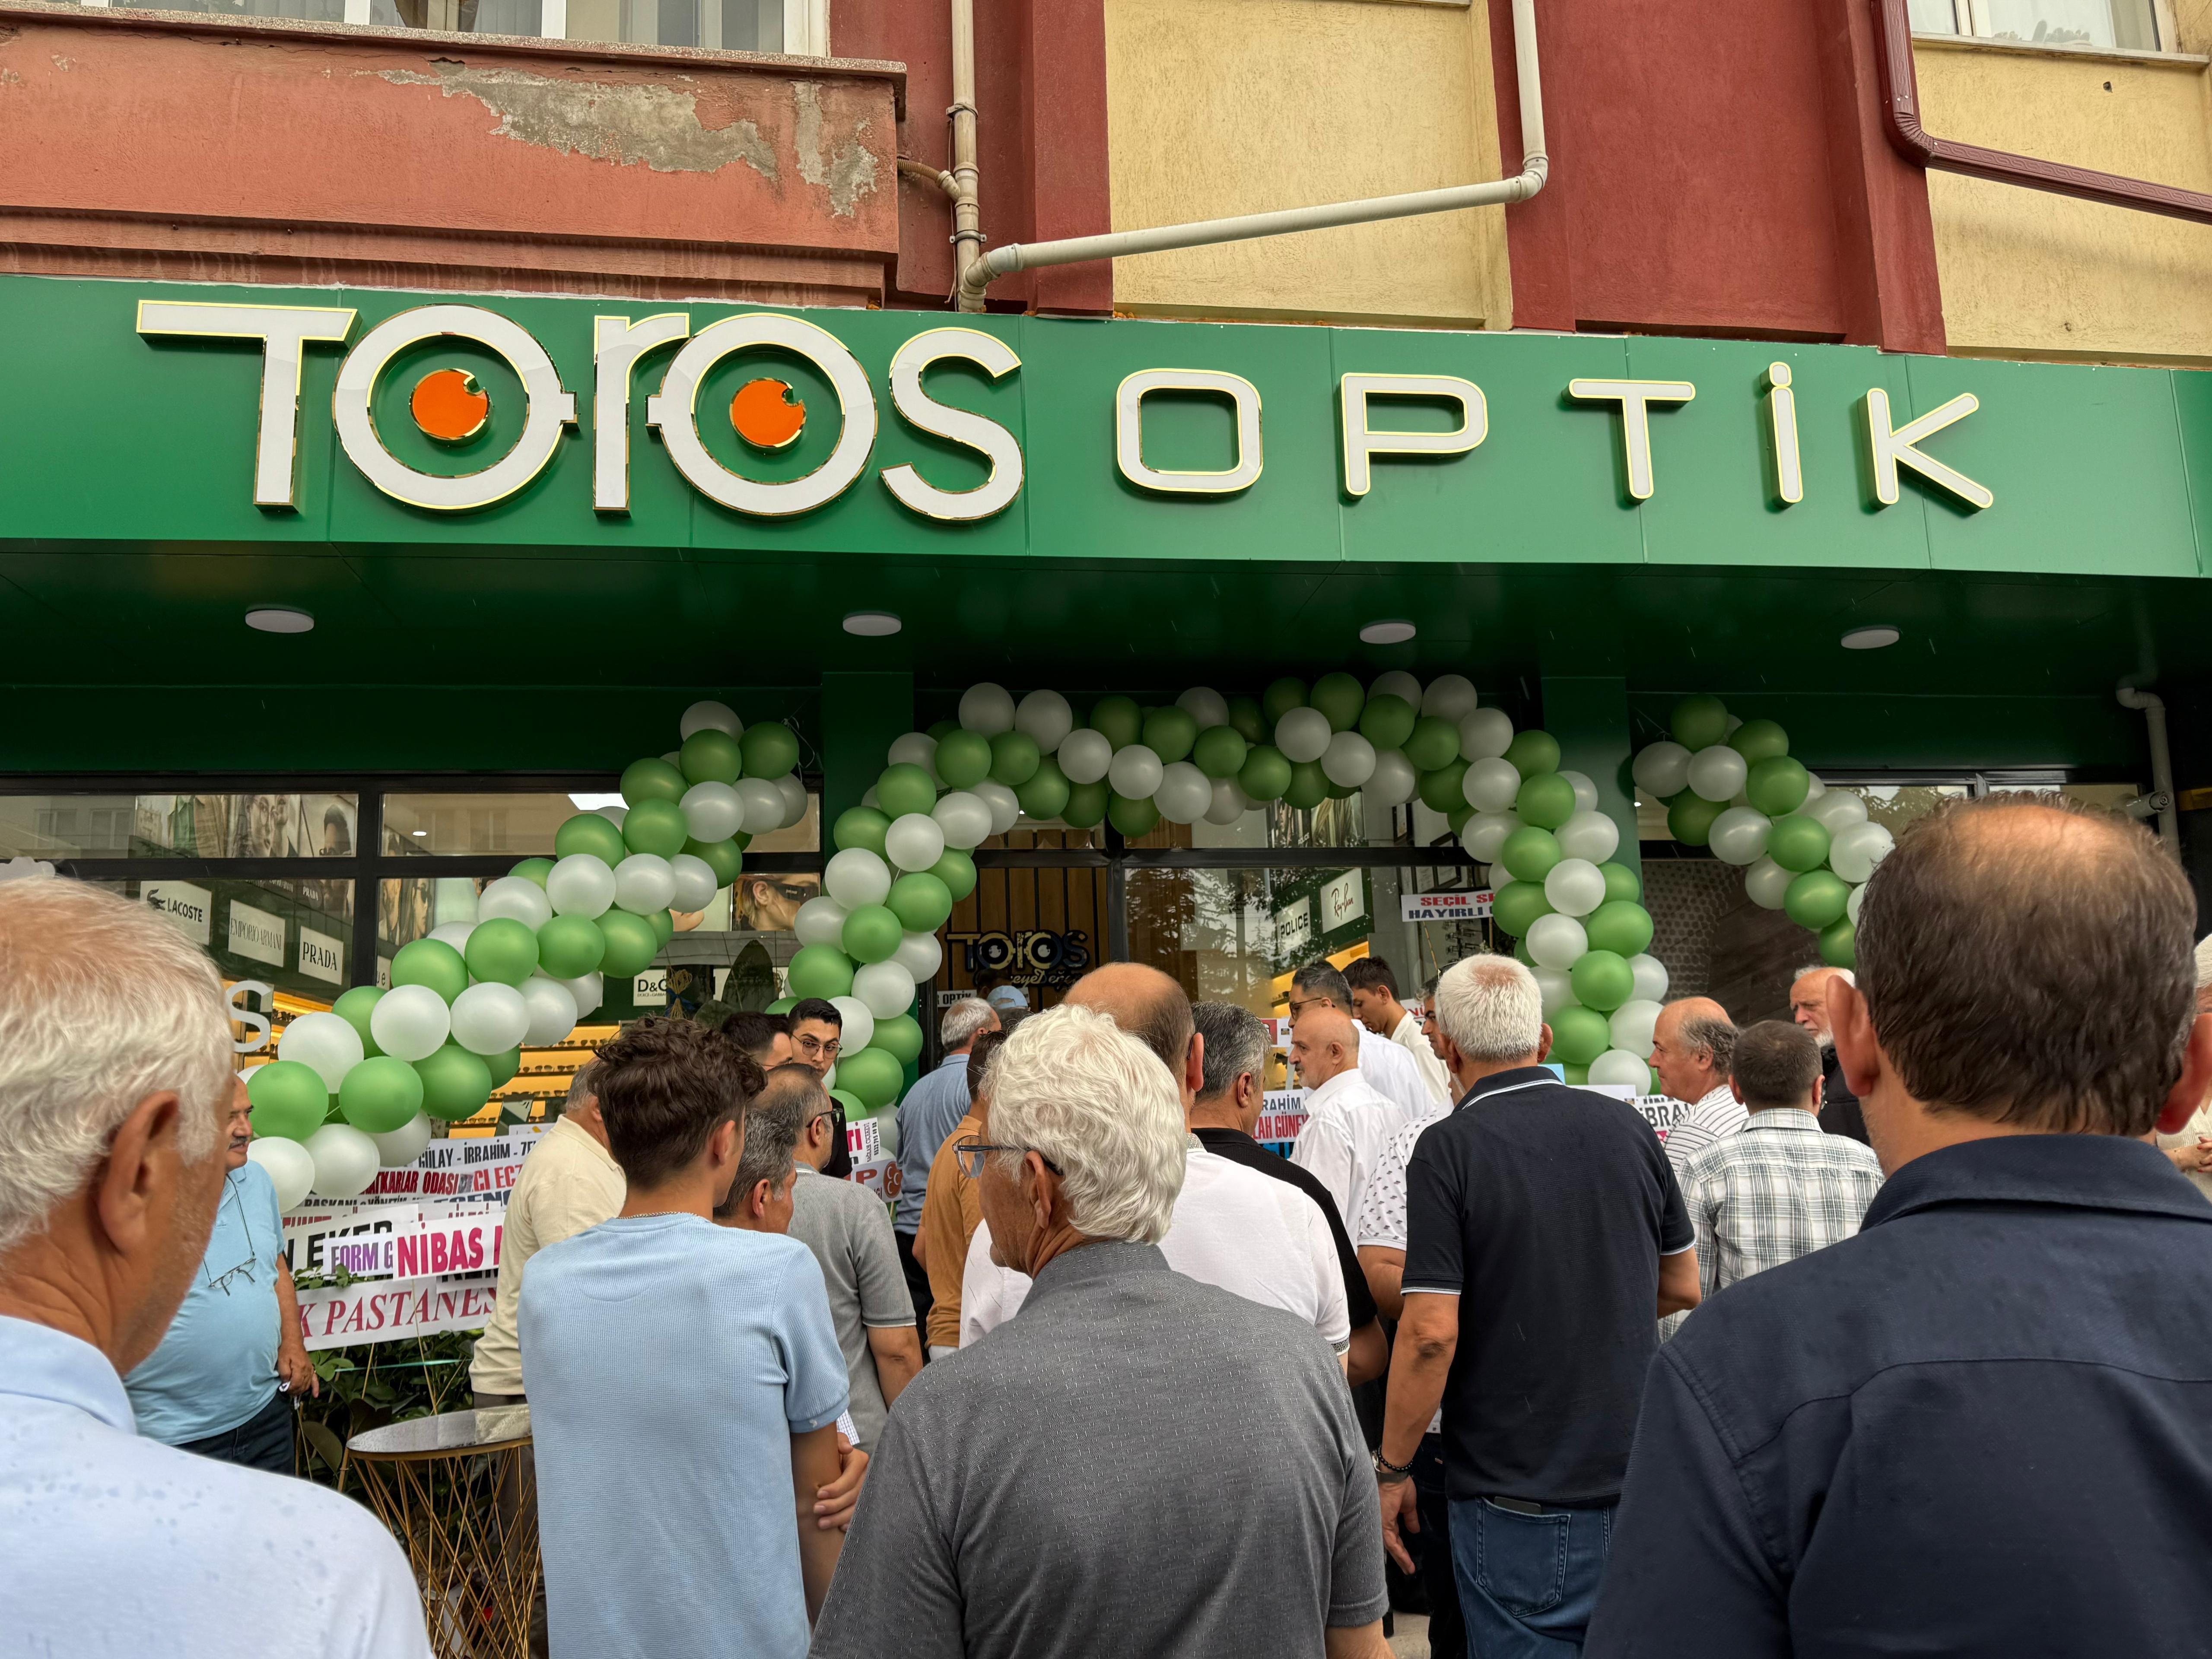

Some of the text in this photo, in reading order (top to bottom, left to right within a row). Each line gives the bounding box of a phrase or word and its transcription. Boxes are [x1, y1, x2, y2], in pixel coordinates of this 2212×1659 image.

[1116, 360, 1994, 512] OPTİK
[167, 898, 203, 923] LACOSTE
[1331, 883, 1354, 921] Ray-Ban
[1408, 907, 1483, 919] HAYIRLI
[1421, 895, 1471, 906] SEÇİL
[230, 918, 282, 950] EMPORIO ARMANI
[1281, 912, 1309, 938] POLICE
[302, 942, 337, 971] PRADA
[422, 1171, 459, 1195] ODASI
[331, 1242, 378, 1274] FORM
[397, 1222, 483, 1278] NİBAS
